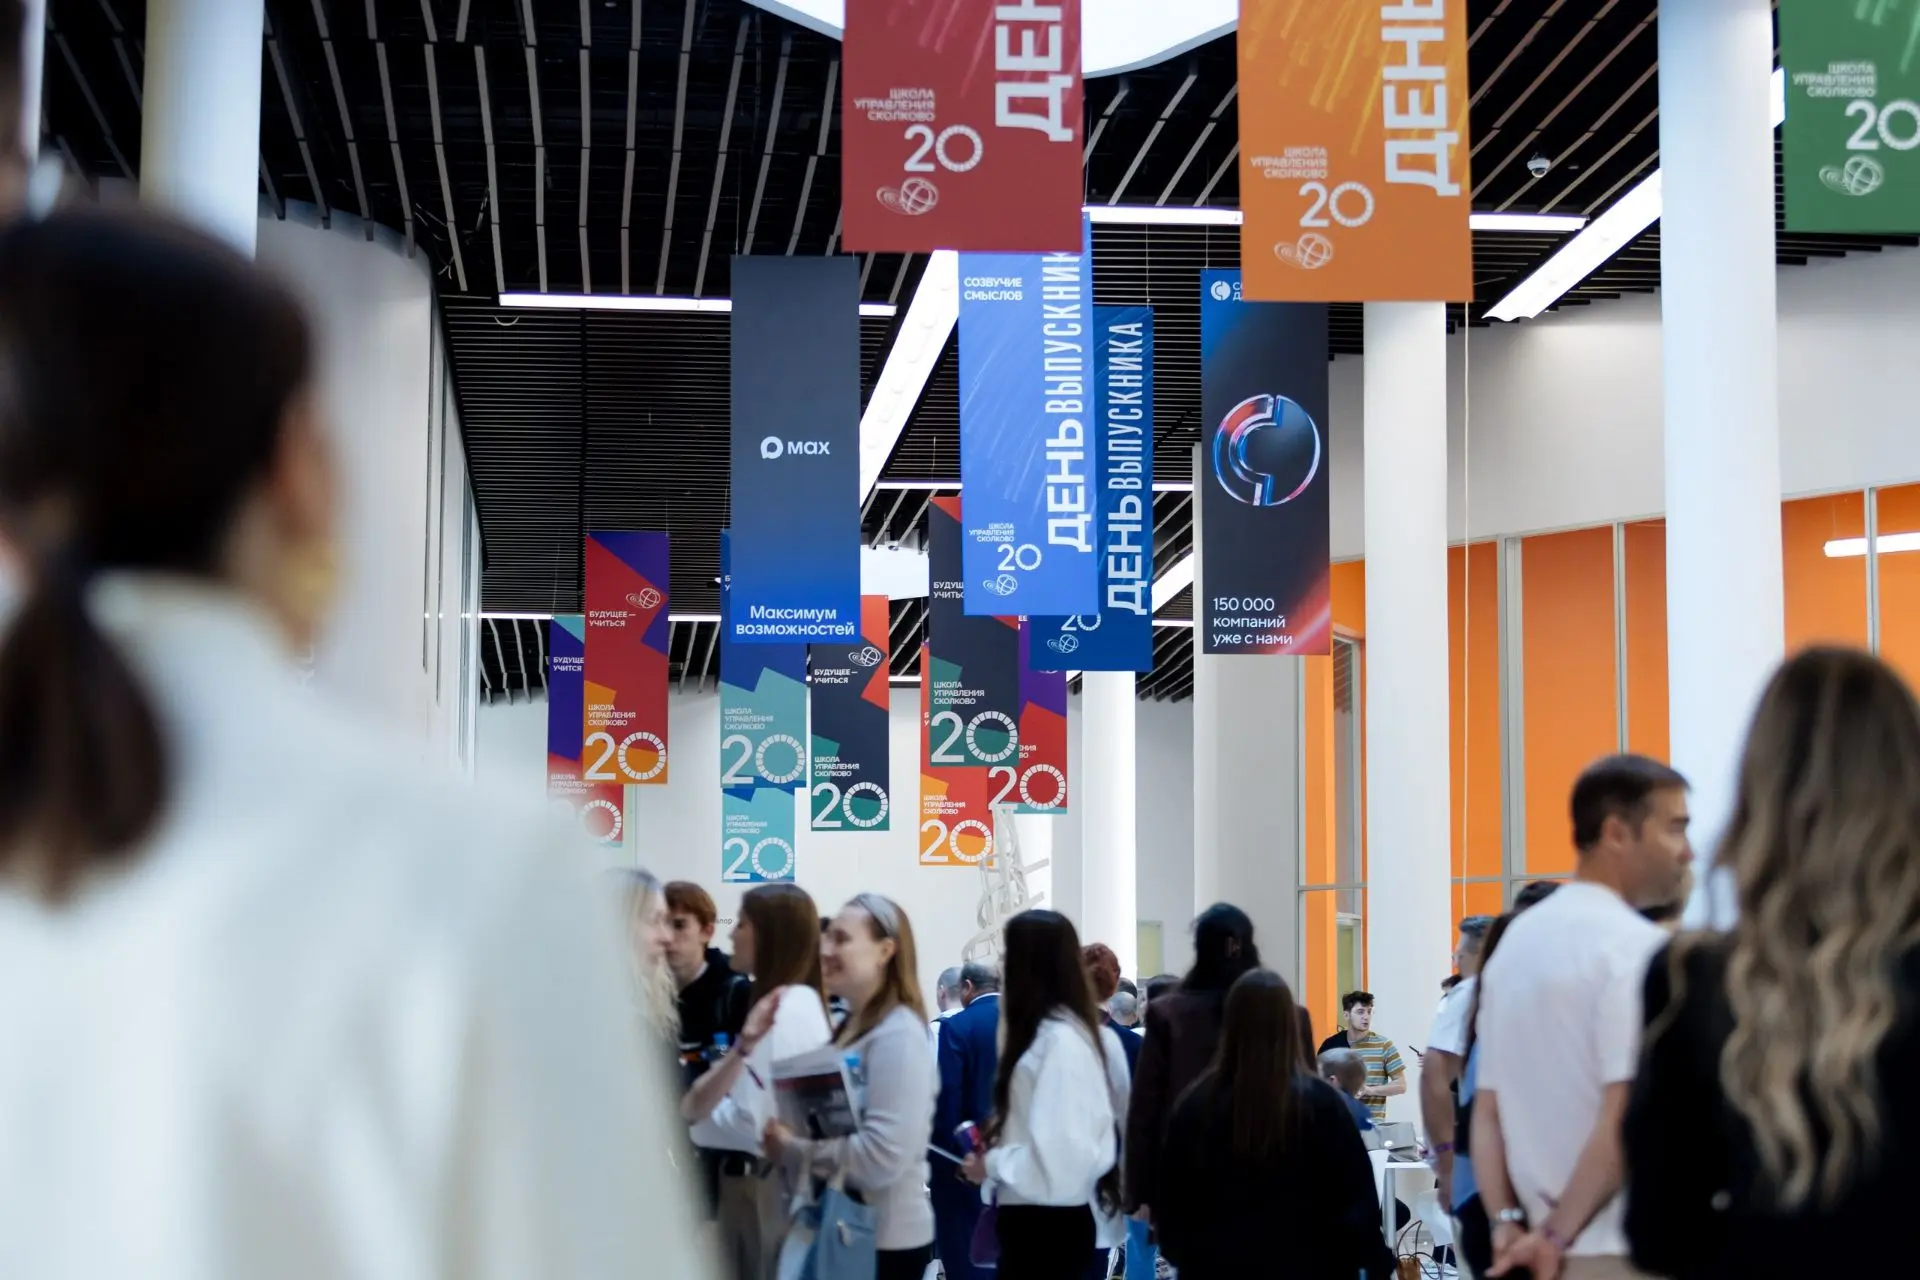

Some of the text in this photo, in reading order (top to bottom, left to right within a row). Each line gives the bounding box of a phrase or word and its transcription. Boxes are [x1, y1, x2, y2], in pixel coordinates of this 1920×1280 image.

[1827, 63, 1875, 73] ШКОЛА
[1792, 73, 1875, 85] УПРАВЛЕНИЯ
[889, 88, 935, 99] ШКОЛА
[1806, 86, 1875, 97] СКОЛКОВО
[854, 99, 935, 110] УПРАВЛЕНИЯ
[867, 110, 936, 121] СКОЛКОВО
[1843, 99, 1920, 150] 20
[903, 125, 984, 172] 20
[1284, 147, 1328, 157] ШКОЛА
[1251, 157, 1328, 168] УПРАВЛЕНИЯ
[1264, 168, 1328, 179] СКОЛКОВО
[1299, 181, 1375, 228] 20
[963, 276, 1023, 288] СОЗВУЧИЕ
[963, 290, 1023, 301] СМЫСЛОВ
[1107, 322, 1148, 616] ДЕНЬ ВЫПУСКНИКА
[1045, 418, 1092, 553] ДЕНЬ
[988, 522, 1014, 530] ШКОЛА
[997, 543, 1042, 571] 20
[1212, 597, 1275, 612] 150 000
[589, 610, 628, 619] БУДУЩЕЕ
[750, 605, 837, 623] Максимум
[589, 619, 626, 627] УЧИТЬСЯ
[1213, 615, 1286, 629] компаний
[735, 622, 855, 636] возможностей
[1212, 634, 1293, 647] уже с нами
[814, 668, 851, 676] БУДУЩЕЕ
[814, 676, 849, 684] УЧИТЬСЯ
[934, 689, 985, 697] УПРАВЛЕНИЯ
[934, 697, 976, 705] СКОЛКОВО
[588, 711, 636, 719] УПРАВЛЕНИЯ
[724, 715, 774, 723] УПРАВЛЕНИЯ
[930, 710, 1018, 763] 20
[584, 731, 667, 780] 20
[721, 734, 806, 785] 20
[814, 763, 860, 771] УПРАВЛЕНИЯ
[988, 764, 1067, 811] 20
[812, 781, 889, 828] 20
[923, 801, 966, 809] УПРАВЛЕНИЯ
[920, 819, 993, 863] 20
[723, 837, 794, 880] 20
